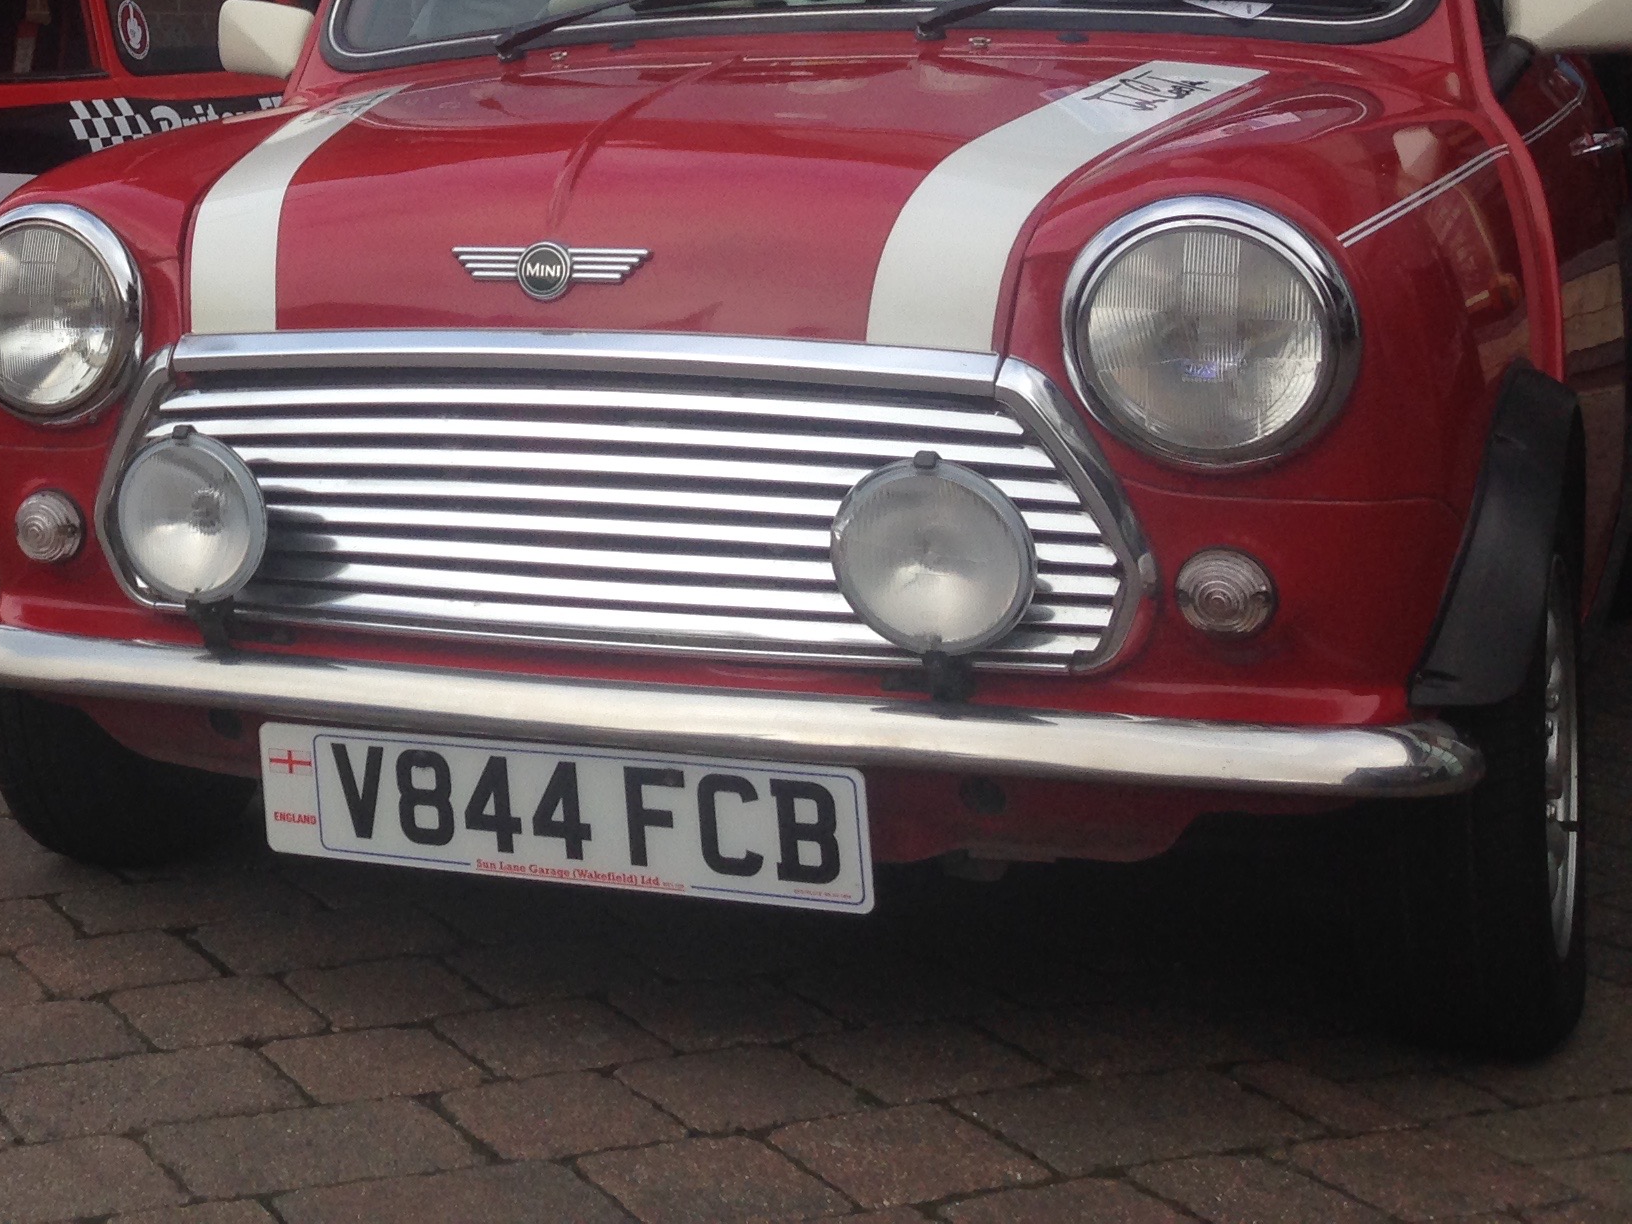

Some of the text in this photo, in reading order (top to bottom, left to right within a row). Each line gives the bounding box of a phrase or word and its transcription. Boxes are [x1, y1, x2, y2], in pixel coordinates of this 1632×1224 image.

[525, 262, 562, 278] MINI
[273, 811, 317, 826] ENGLAND
[330, 742, 842, 886] V844 FCB
[475, 858, 496, 871] Sun
[499, 860, 527, 874] Lane
[528, 863, 571, 880] Garage
[572, 867, 639, 887] (Wakefield)
[640, 873, 661, 887] Ltd
